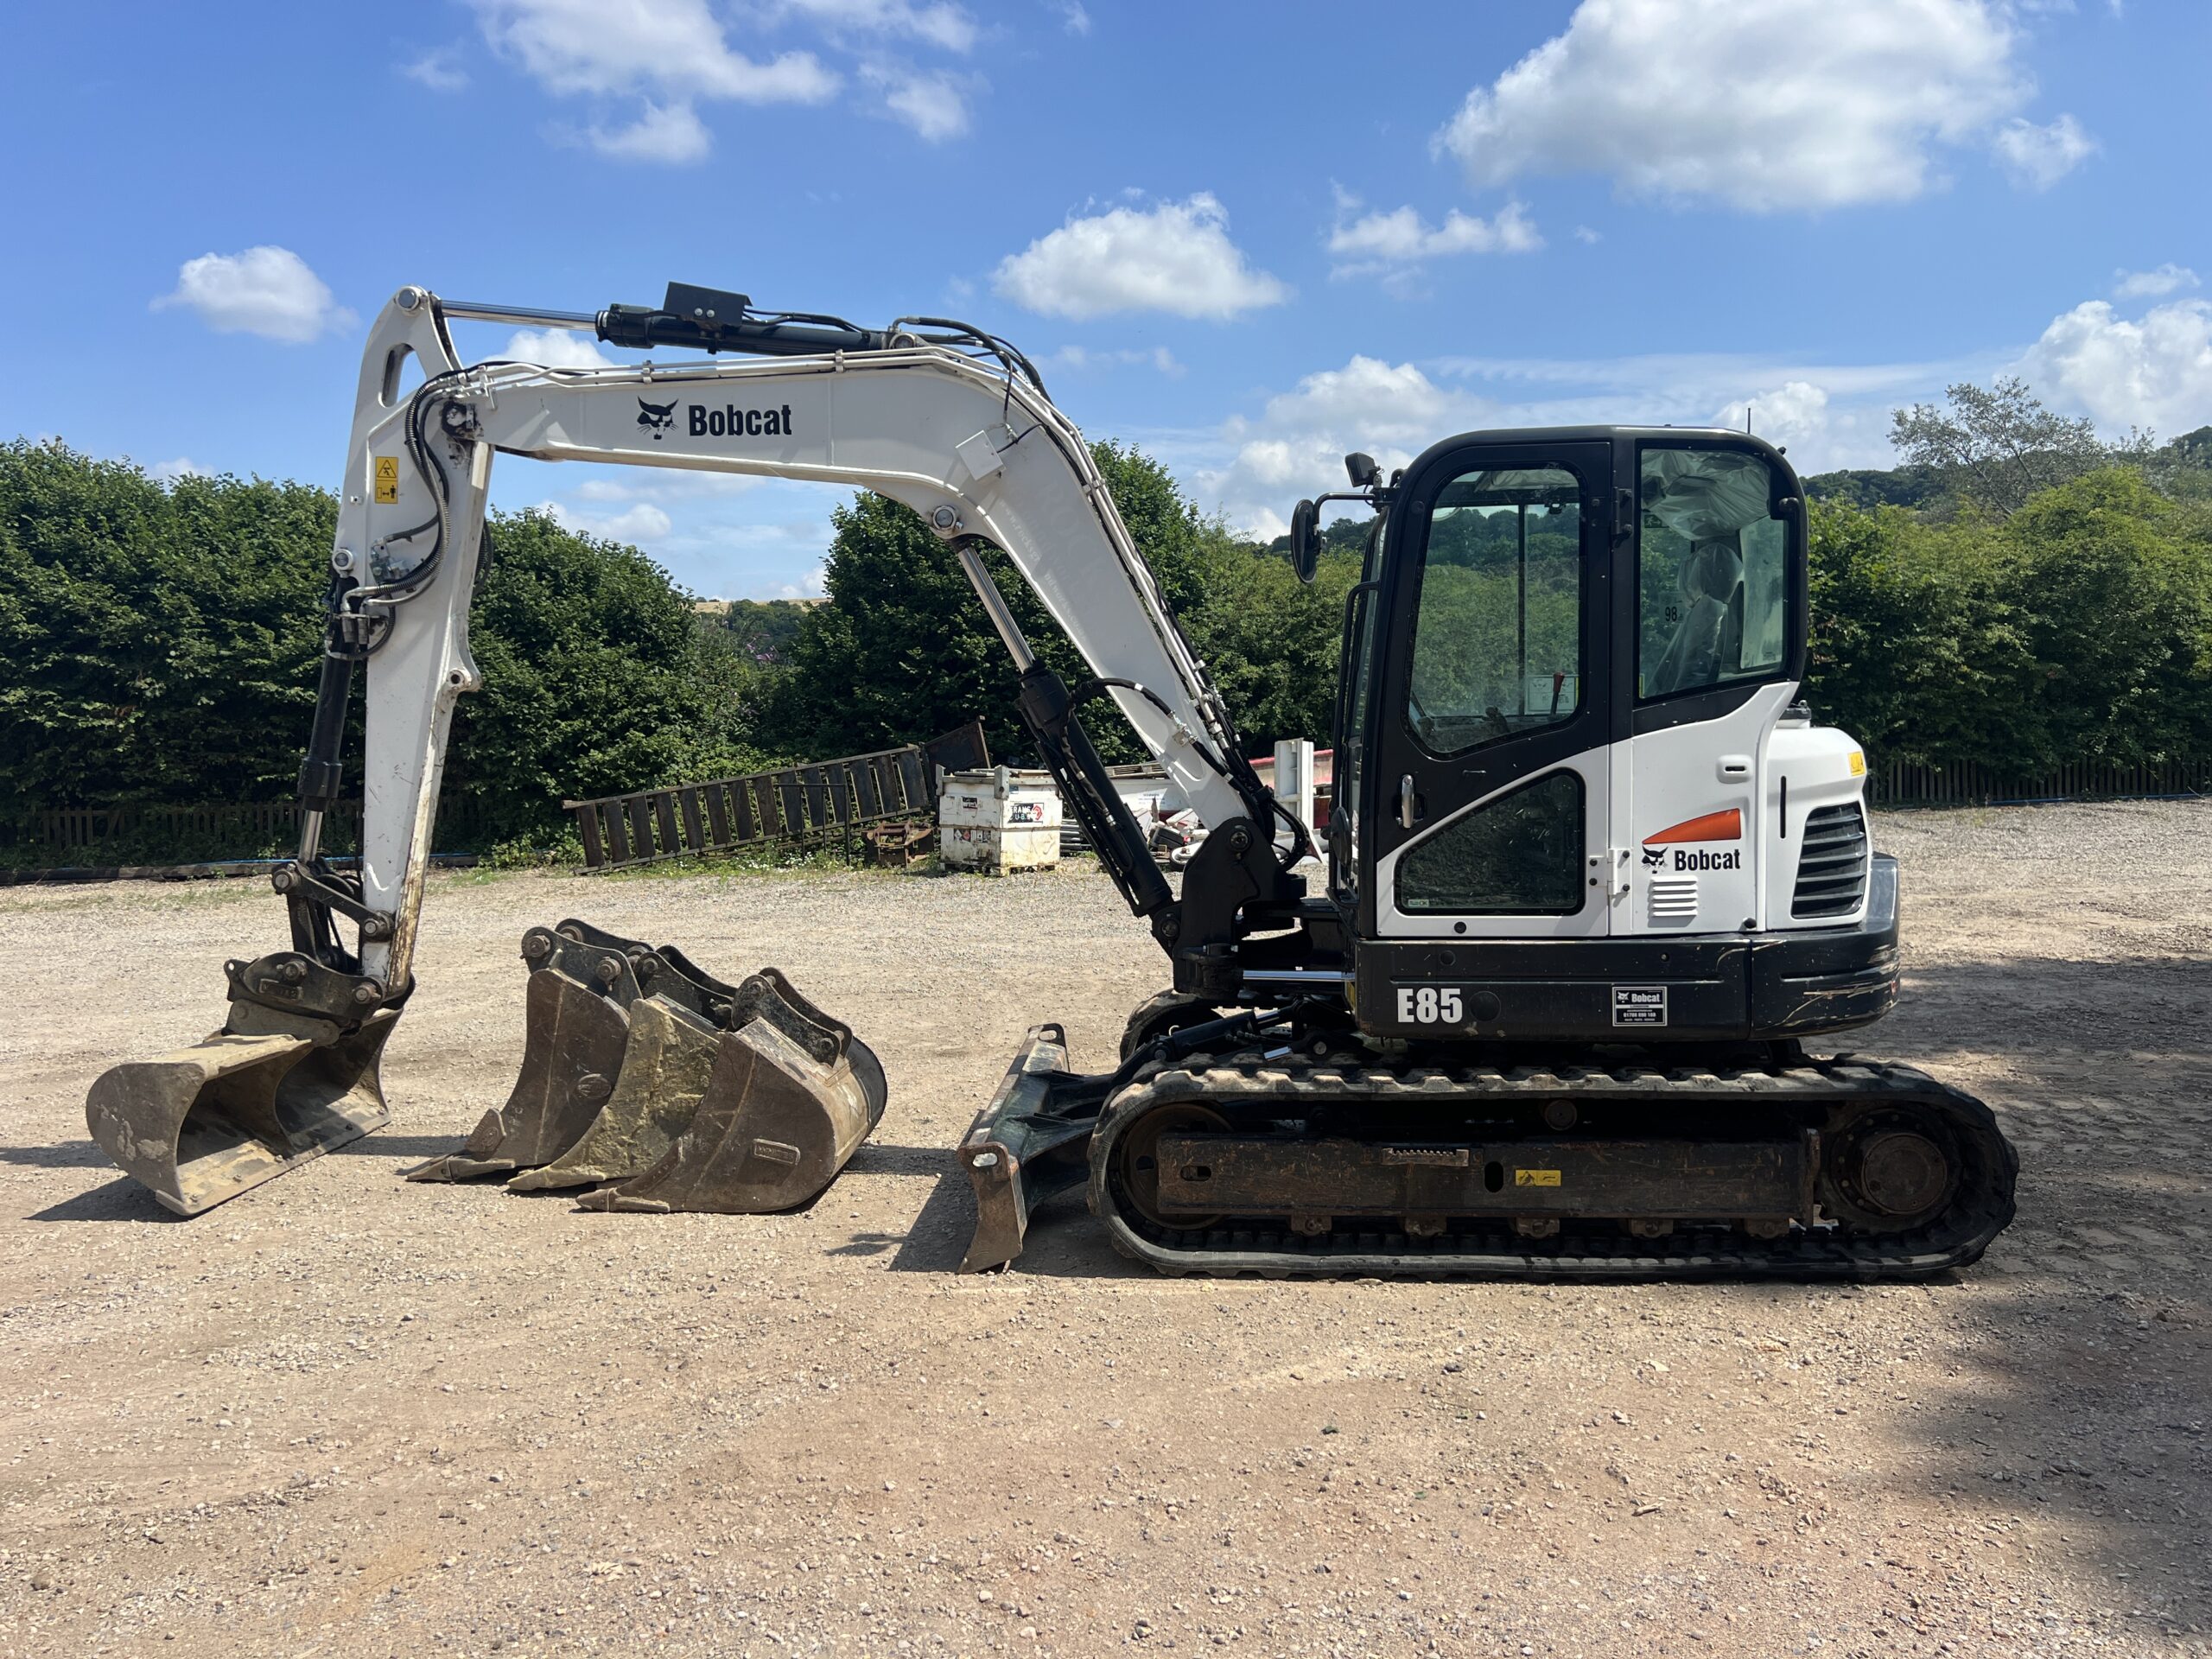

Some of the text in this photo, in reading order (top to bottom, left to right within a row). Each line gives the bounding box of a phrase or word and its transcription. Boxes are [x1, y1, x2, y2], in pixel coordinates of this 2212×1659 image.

[689, 404, 792, 436] Bobcat
[1664, 606, 1678, 622] 98
[1675, 849, 1740, 872] Bobcat
[1397, 987, 1463, 1024] E85
[1631, 993, 1660, 1002] Bobcat
